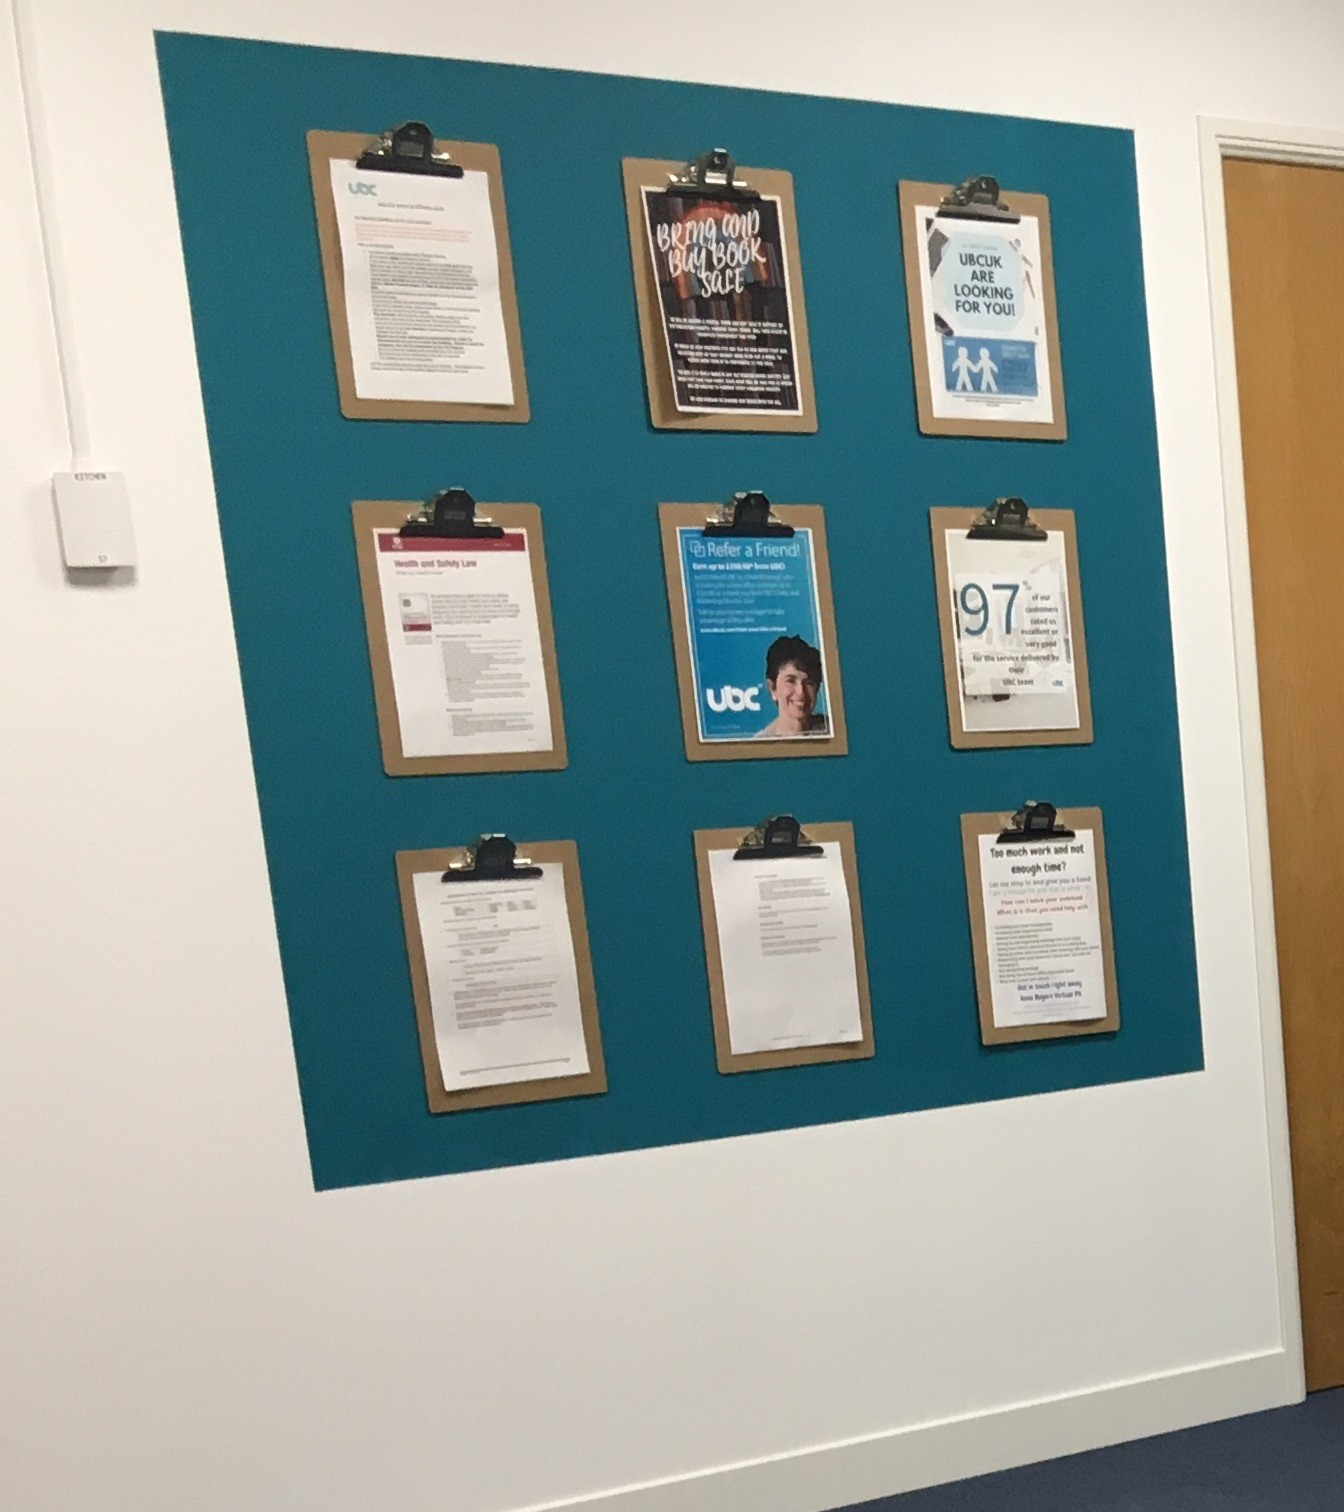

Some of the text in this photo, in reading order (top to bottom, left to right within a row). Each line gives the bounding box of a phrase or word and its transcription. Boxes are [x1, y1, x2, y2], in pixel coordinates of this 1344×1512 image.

[657, 217, 717, 252] BRING
[669, 236, 767, 279] BUY BOOK
[959, 253, 1003, 269] UBCUK
[701, 268, 745, 298] SALE
[971, 269, 995, 284] ARE
[954, 283, 1014, 301] LOOKING
[955, 299, 1016, 316] FOR YOU!
[707, 541, 800, 558] Refer a Friend!
[1020, 654, 1050, 662] delivered
[706, 685, 761, 713] ubc
[990, 843, 1084, 858] Too much work and not
[1011, 860, 1067, 877] enough time?
